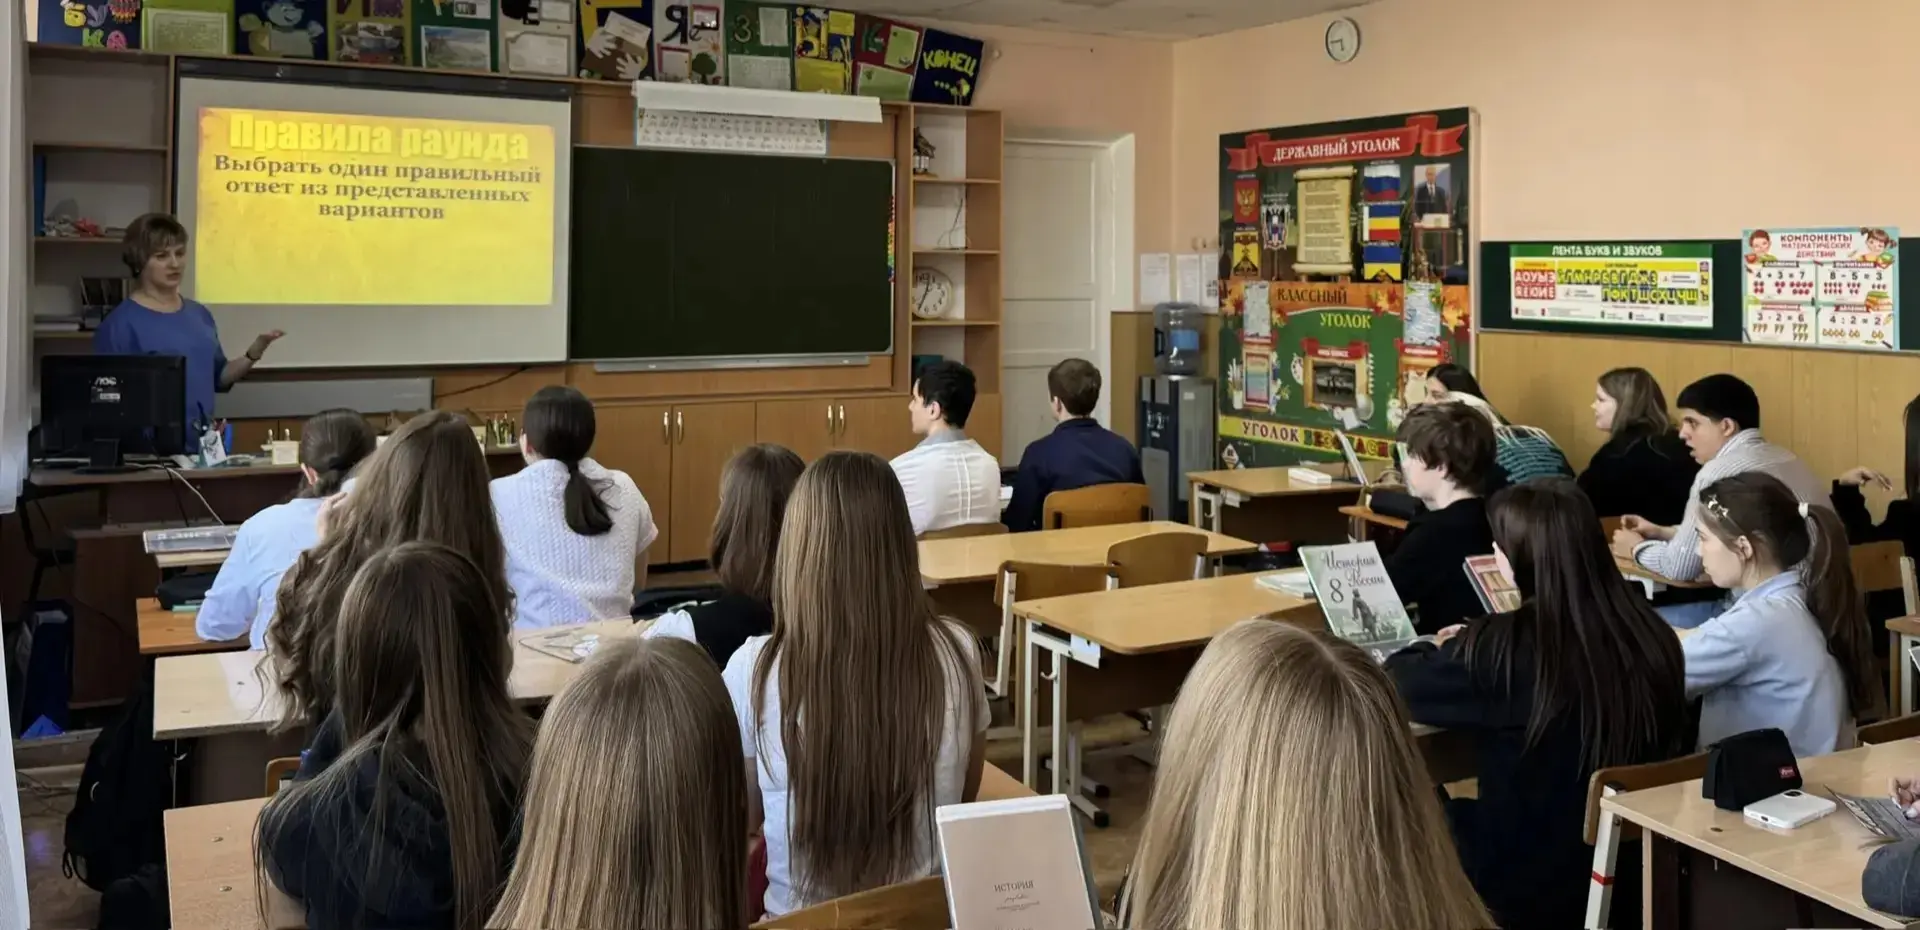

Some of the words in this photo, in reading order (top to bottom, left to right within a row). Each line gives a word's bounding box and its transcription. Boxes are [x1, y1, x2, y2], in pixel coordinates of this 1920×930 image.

[922, 50, 977, 76] КОНЕЦ
[229, 113, 393, 153] Правила
[401, 127, 529, 161] раунда
[1273, 137, 1348, 162] ДЕРЖАВНЫЙ
[1351, 137, 1401, 154] УГОЛОК
[214, 154, 322, 175] Выбрать
[329, 163, 388, 180] один
[395, 166, 542, 184] правильный
[225, 180, 294, 195] ответ
[301, 182, 328, 197] из
[335, 184, 530, 202] представленных
[318, 203, 445, 221] вариантов
[1780, 234, 1852, 242] КОМПОНЕНТЫ
[1552, 245, 1583, 256] ЛЕНТА
[1584, 245, 1611, 256] БУКВ
[1612, 246, 1621, 256] И
[1622, 246, 1663, 256] ЗВУКОВ
[1756, 271, 1761, 279] 4
[1778, 271, 1783, 279] 3
[1800, 271, 1805, 279] 7
[1830, 271, 1836, 280] 8
[1852, 271, 1858, 280] 5
[1876, 272, 1882, 280] 3
[1277, 287, 1348, 304] КЛАССНЫЙ
[1320, 313, 1372, 329] УГОЛОК
[1757, 313, 1763, 321] 3
[1776, 313, 1782, 321] 2
[1850, 316, 1856, 324] 2
[1874, 317, 1881, 325] 2
[1242, 421, 1300, 442] УГОЛОК
[1321, 550, 1376, 577] История
[1329, 578, 1345, 604] 8
[993, 880, 1034, 893] ИСТОРИЯ
